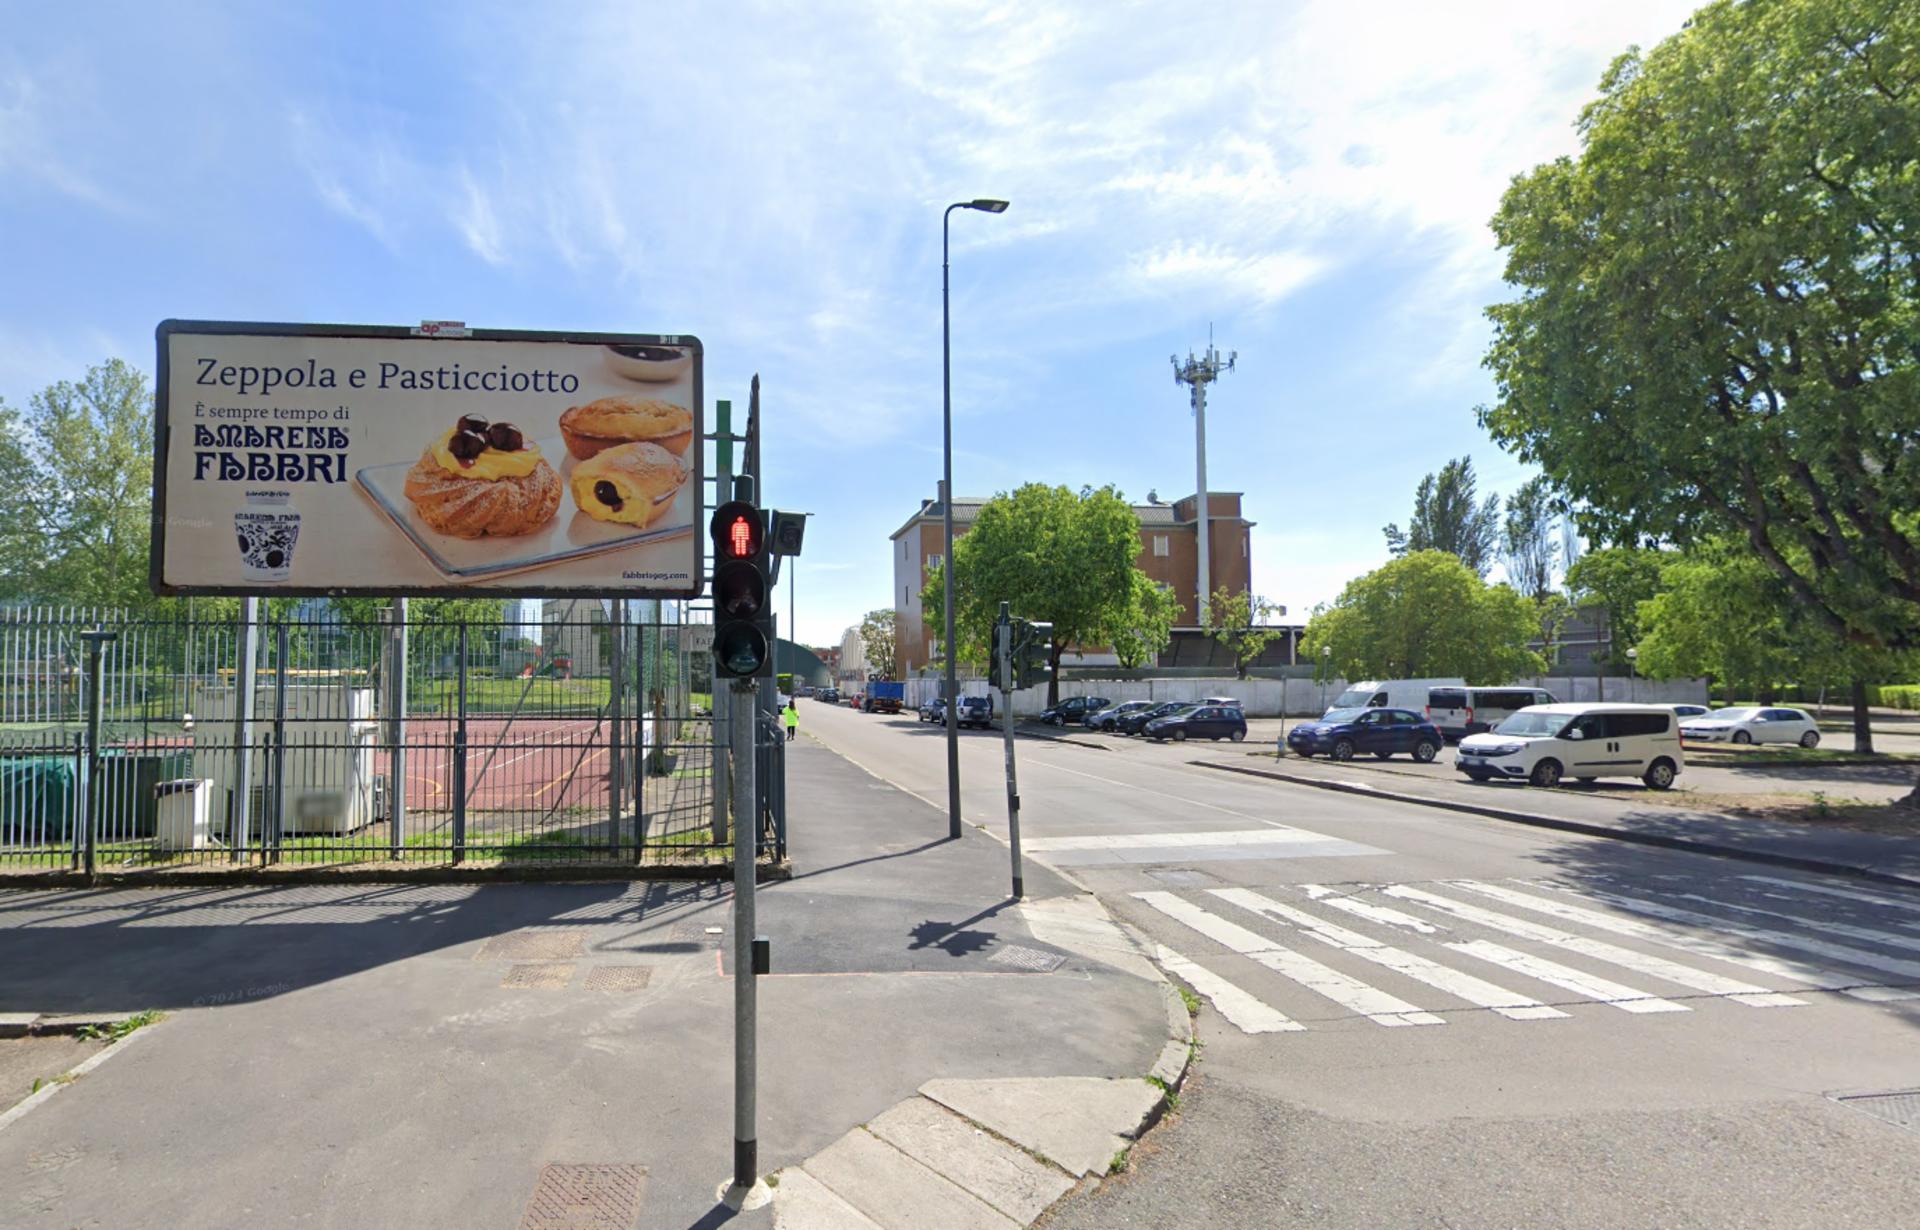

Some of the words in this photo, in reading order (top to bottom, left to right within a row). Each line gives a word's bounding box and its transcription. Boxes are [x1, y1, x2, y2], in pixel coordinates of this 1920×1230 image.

[196, 358, 337, 396] Zeppola
[348, 368, 367, 389] e
[377, 361, 580, 394] Pasticciotto
[194, 401, 205, 417] È
[209, 406, 269, 422] sempre
[273, 408, 328, 423] tempo
[333, 406, 350, 420] di
[193, 451, 349, 484] FABBRI
